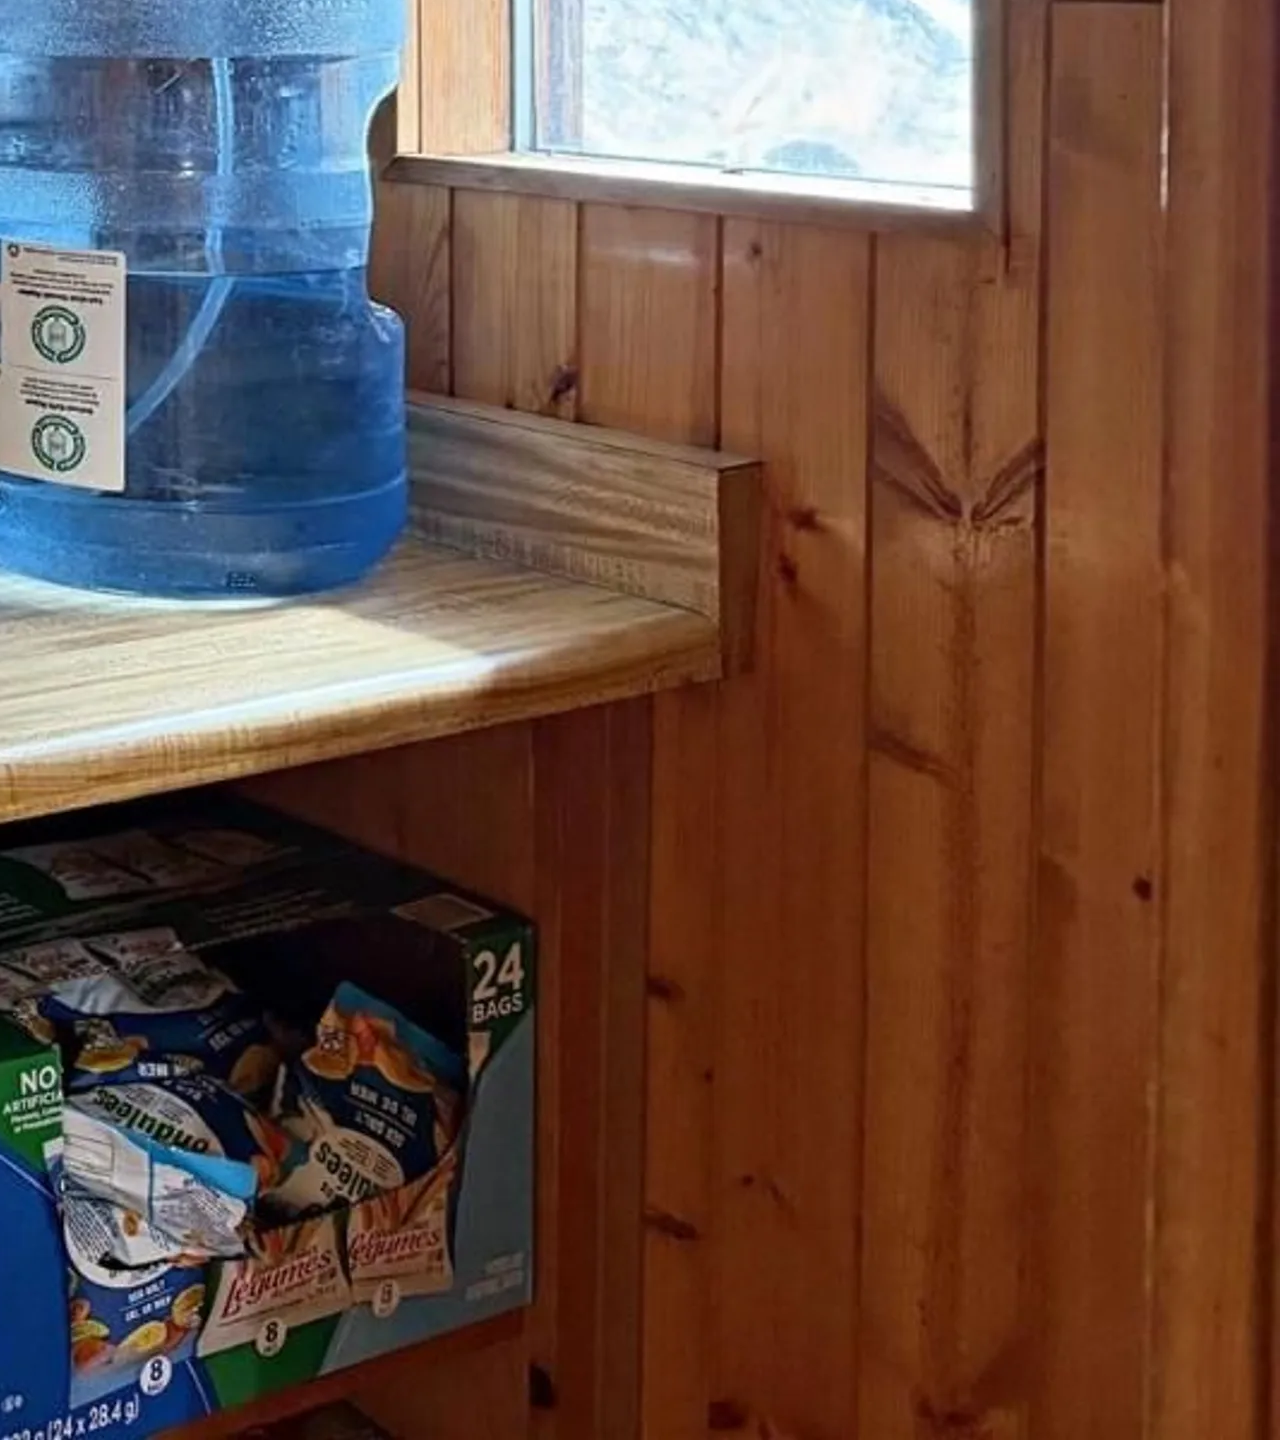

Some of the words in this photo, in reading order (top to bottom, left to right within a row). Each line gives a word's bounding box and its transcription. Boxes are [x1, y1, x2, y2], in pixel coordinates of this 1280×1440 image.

[472, 941, 525, 1002] 24
[472, 992, 524, 1024] BAGS
[19, 1065, 57, 1096] NO
[265, 1320, 279, 1343] 8
[150, 1359, 164, 1382] 8
[75, 1419, 86, 1435] x
[89, 1399, 123, 1431] 28.4
